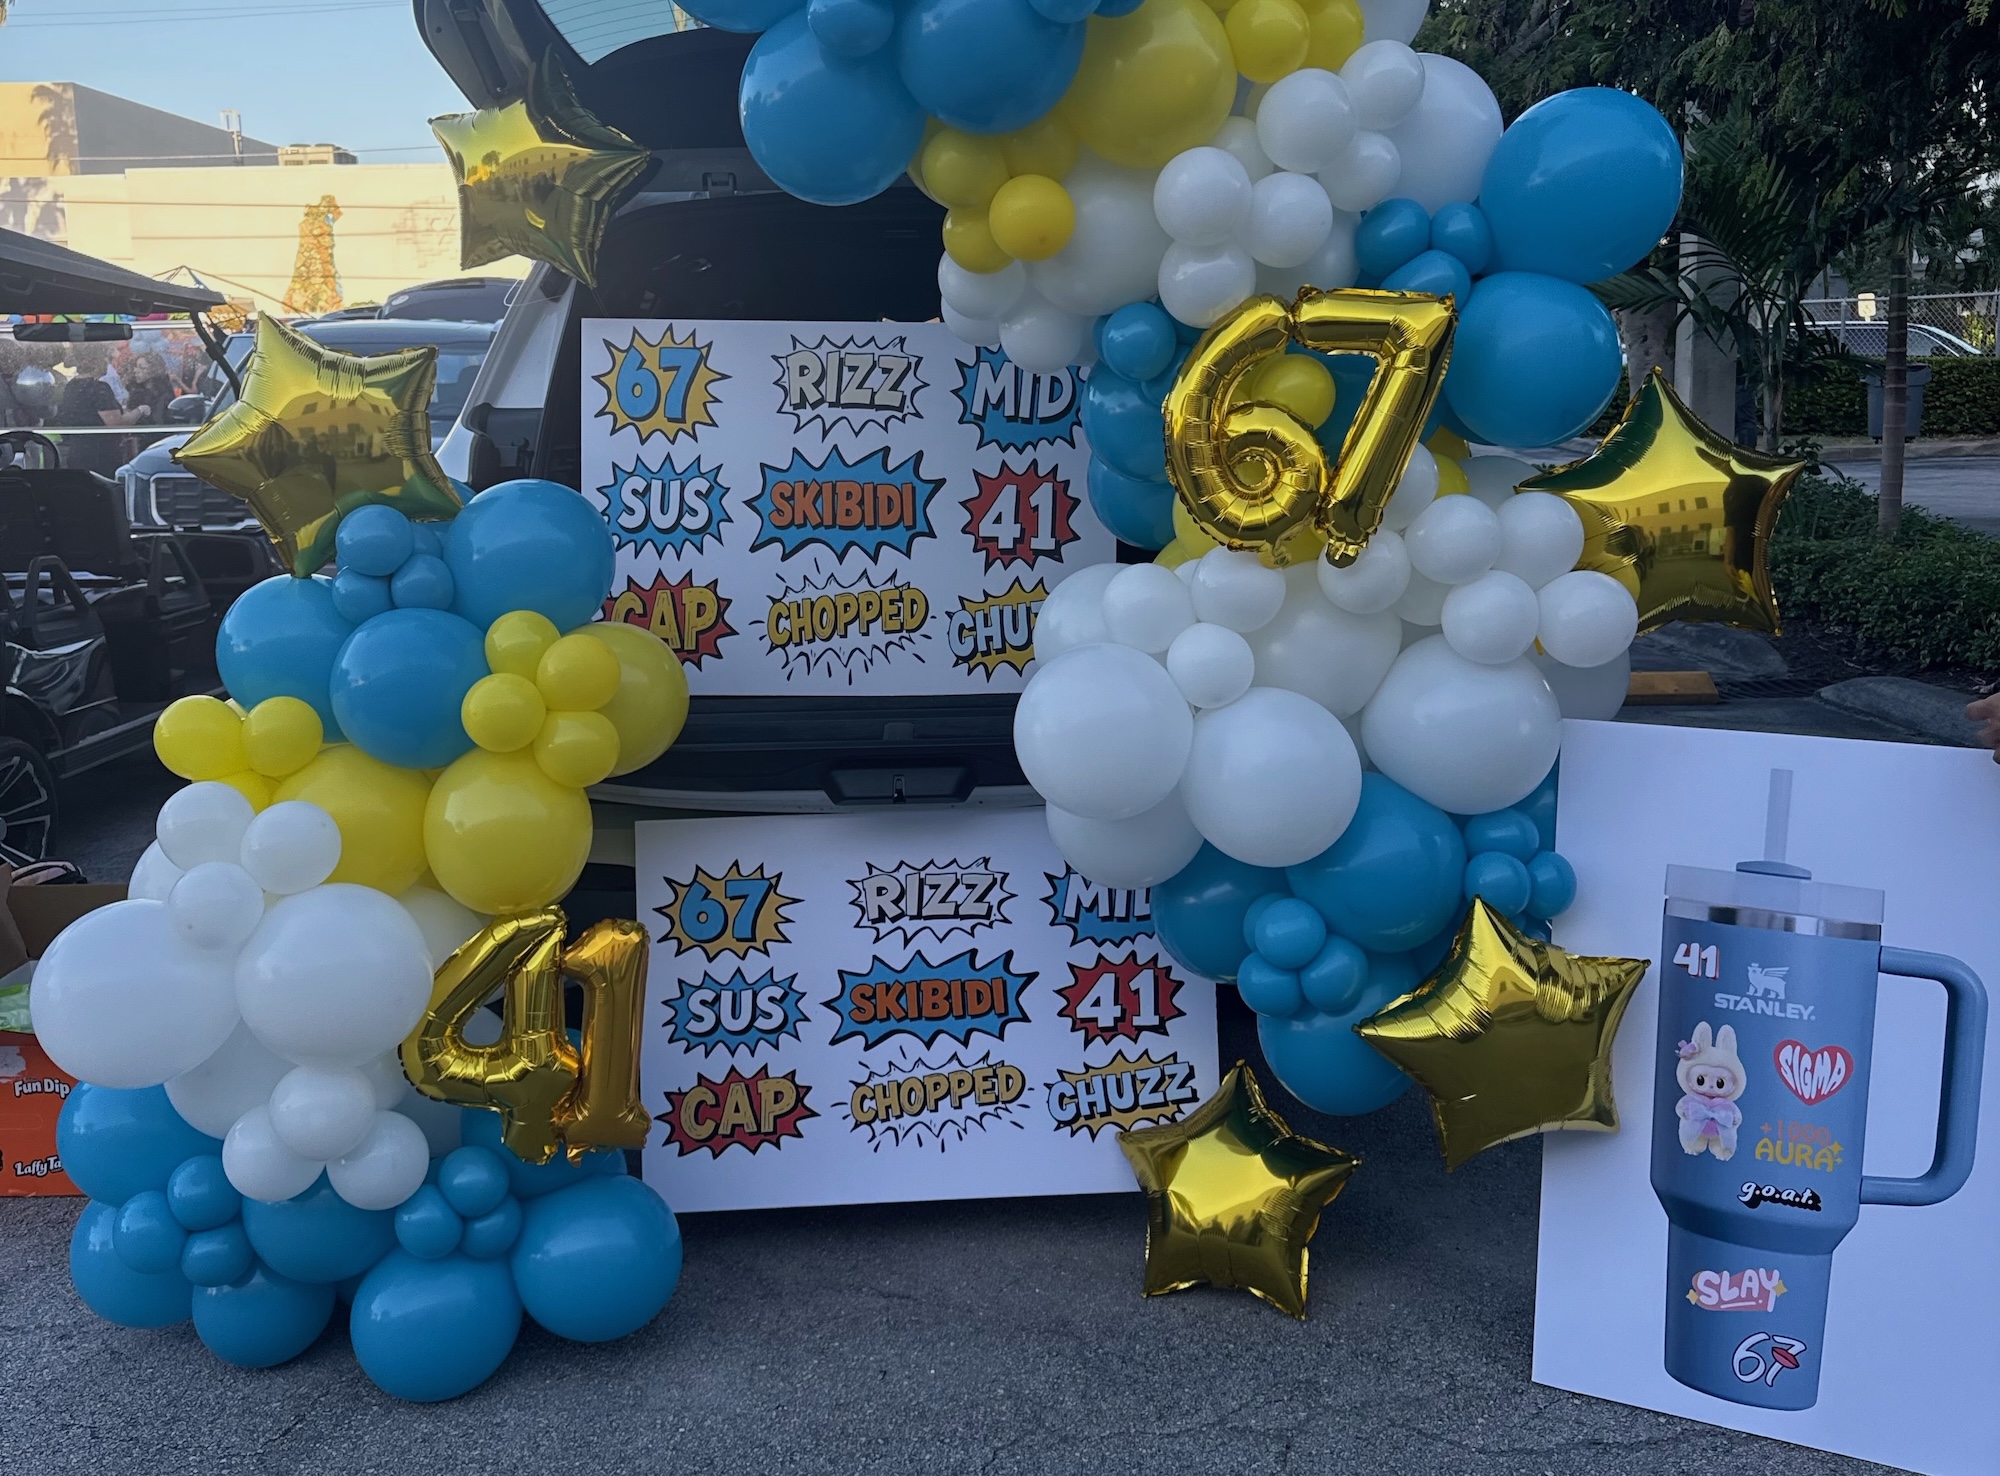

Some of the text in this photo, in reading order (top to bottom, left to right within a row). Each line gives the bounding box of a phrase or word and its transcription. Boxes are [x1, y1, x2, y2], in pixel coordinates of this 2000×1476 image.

[615, 346, 704, 421] 67
[785, 349, 912, 411] RIZZ
[970, 361, 1076, 425] MID
[1161, 284, 1457, 568] 67
[616, 475, 713, 534] SUS
[768, 479, 916, 531] SKIBIDI
[978, 482, 1060, 552] 41
[766, 587, 929, 649] CHOPPED
[948, 600, 1045, 662] CHU
[679, 877, 773, 944] 67
[862, 872, 999, 923] RIZZ
[1673, 943, 1719, 979] 41
[683, 983, 790, 1034] SUS
[848, 977, 1009, 1025] SKIBIDI
[1075, 971, 1163, 1033] 41
[400, 905, 651, 1167] 41
[14, 1078, 71, 1099] Fun Dip
[849, 1065, 1027, 1127] CHOPPED
[1046, 1062, 1200, 1125] CHUZZ
[1779, 1045, 1846, 1099] SIGMA
[681, 1077, 801, 1142] CAP
[14, 1159, 48, 1177] Laffy
[1755, 1138, 1834, 1172] AURA
[1696, 1268, 1780, 1312] SLAY
[1732, 1332, 1805, 1388] 67
